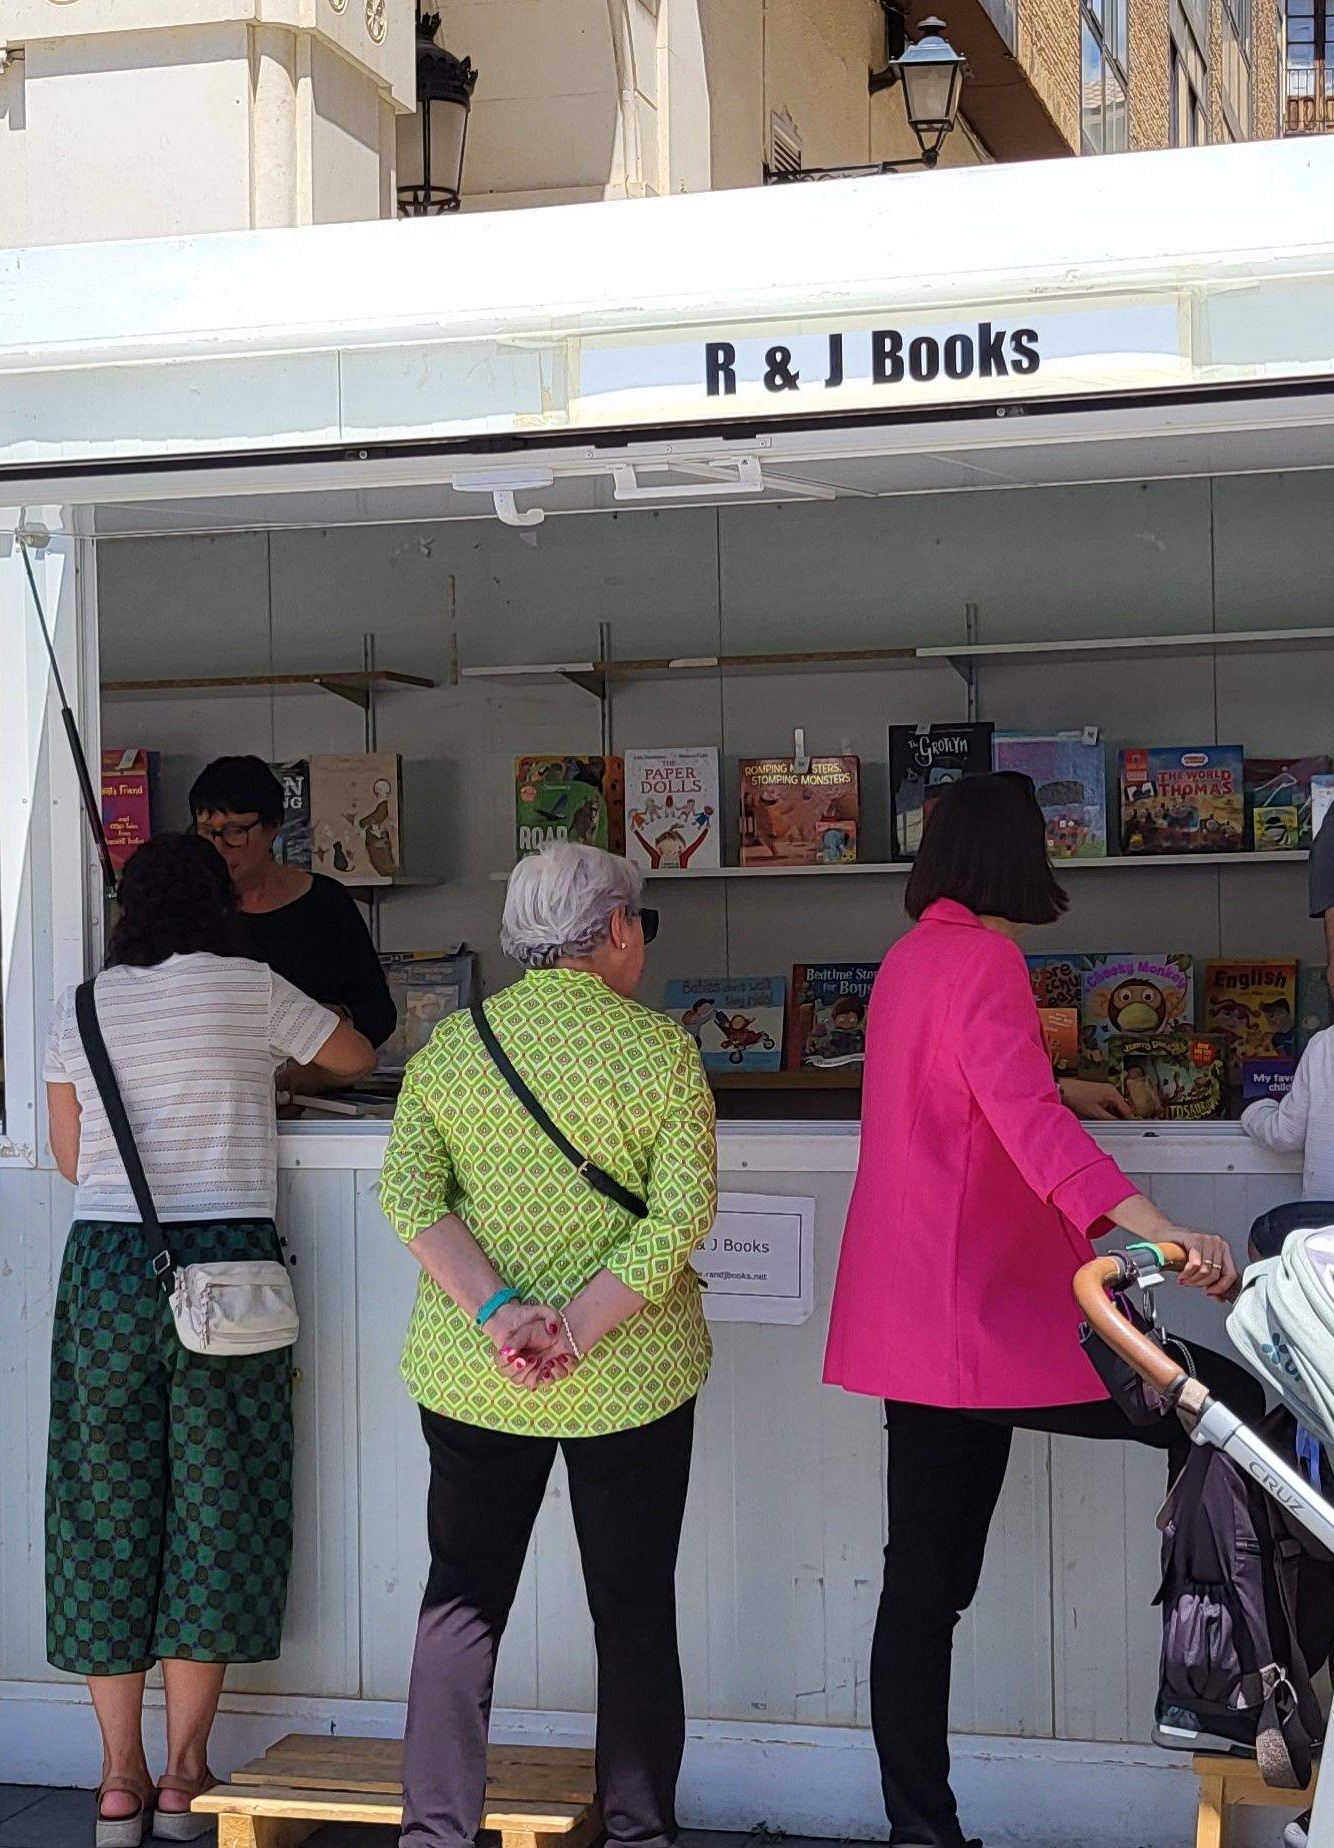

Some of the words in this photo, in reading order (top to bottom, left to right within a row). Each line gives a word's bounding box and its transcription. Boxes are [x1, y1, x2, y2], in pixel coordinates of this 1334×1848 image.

[705, 341, 737, 397] R
[763, 345, 800, 394] &
[824, 333, 845, 389] J
[872, 322, 1042, 386] Books
[644, 767, 696, 780] PAPER
[743, 764, 789, 777] ROMPING
[1186, 769, 1232, 781] WORLD
[641, 779, 702, 793] DOLLS
[751, 774, 799, 786] STOMPING
[800, 772, 852, 785] MONSTERS
[1158, 782, 1233, 797] THOMAS
[282, 796, 303, 808] NG
[806, 968, 853, 981] Bedtime
[1138, 961, 1186, 989] Monkey
[1214, 968, 1288, 990] English
[1253, 1073, 1272, 1084] My
[710, 1239, 718, 1252] J
[723, 1239, 770, 1254] Books
[1248, 1460, 1306, 1516] CRUZ
